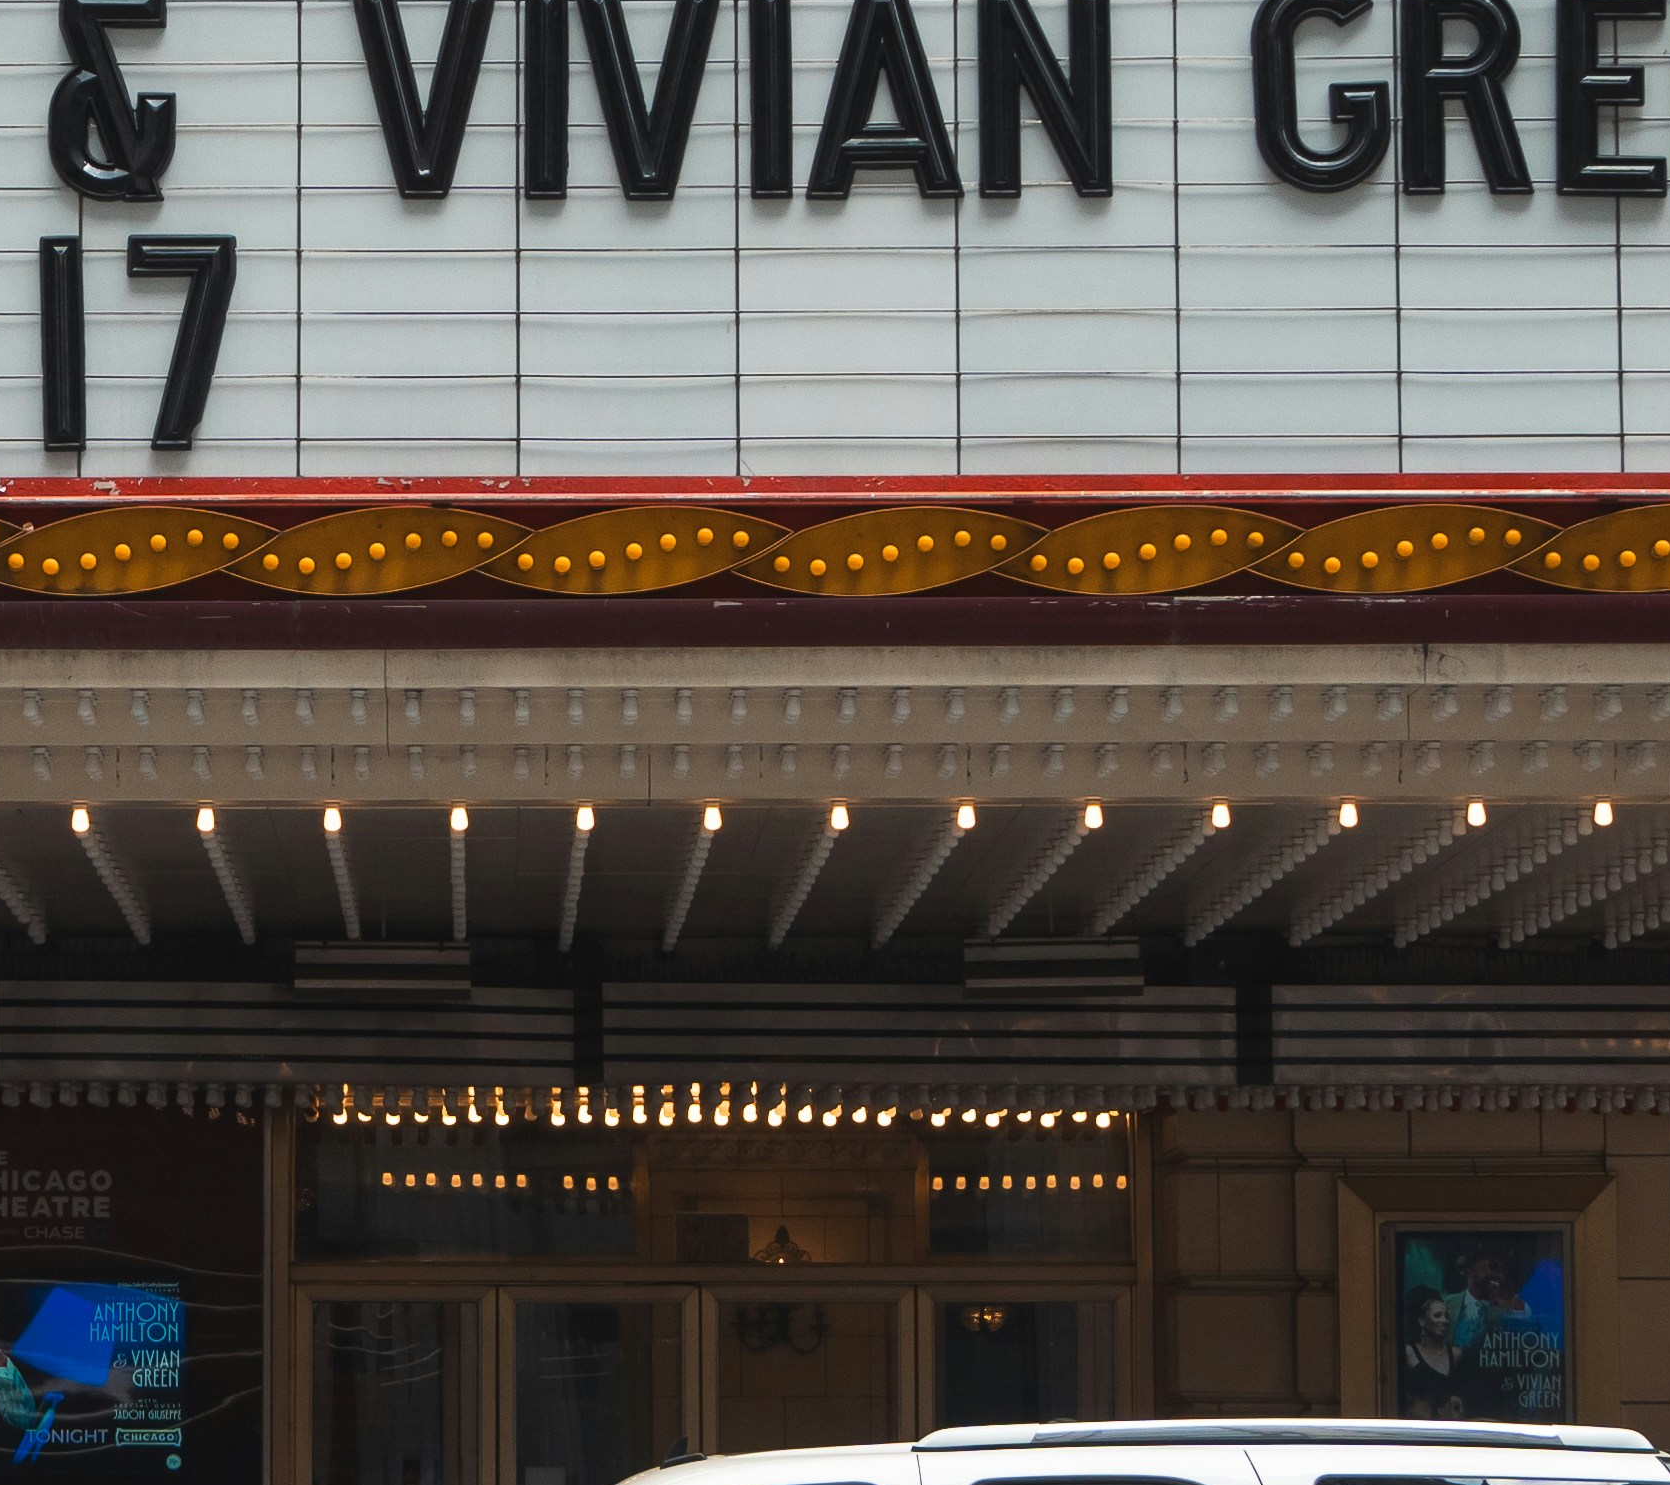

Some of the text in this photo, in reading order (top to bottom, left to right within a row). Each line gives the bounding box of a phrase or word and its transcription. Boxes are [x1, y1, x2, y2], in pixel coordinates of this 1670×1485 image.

[40, 233, 238, 453] 17
[24, 1226, 85, 1240] CHASE
[94, 1302, 179, 1322] ANTHONY
[90, 1322, 179, 1343] HAMILTON
[1483, 1331, 1559, 1349] ANTHONY
[113, 1349, 180, 1369] & VIVIAN
[1479, 1349, 1560, 1367] HAMILTON
[132, 1368, 179, 1387] GREEN
[1517, 1373, 1562, 1391] VIVIAN
[1518, 1391, 1561, 1408] GREEN
[25, 1429, 175, 1444] TONIGHT CHICAGO
